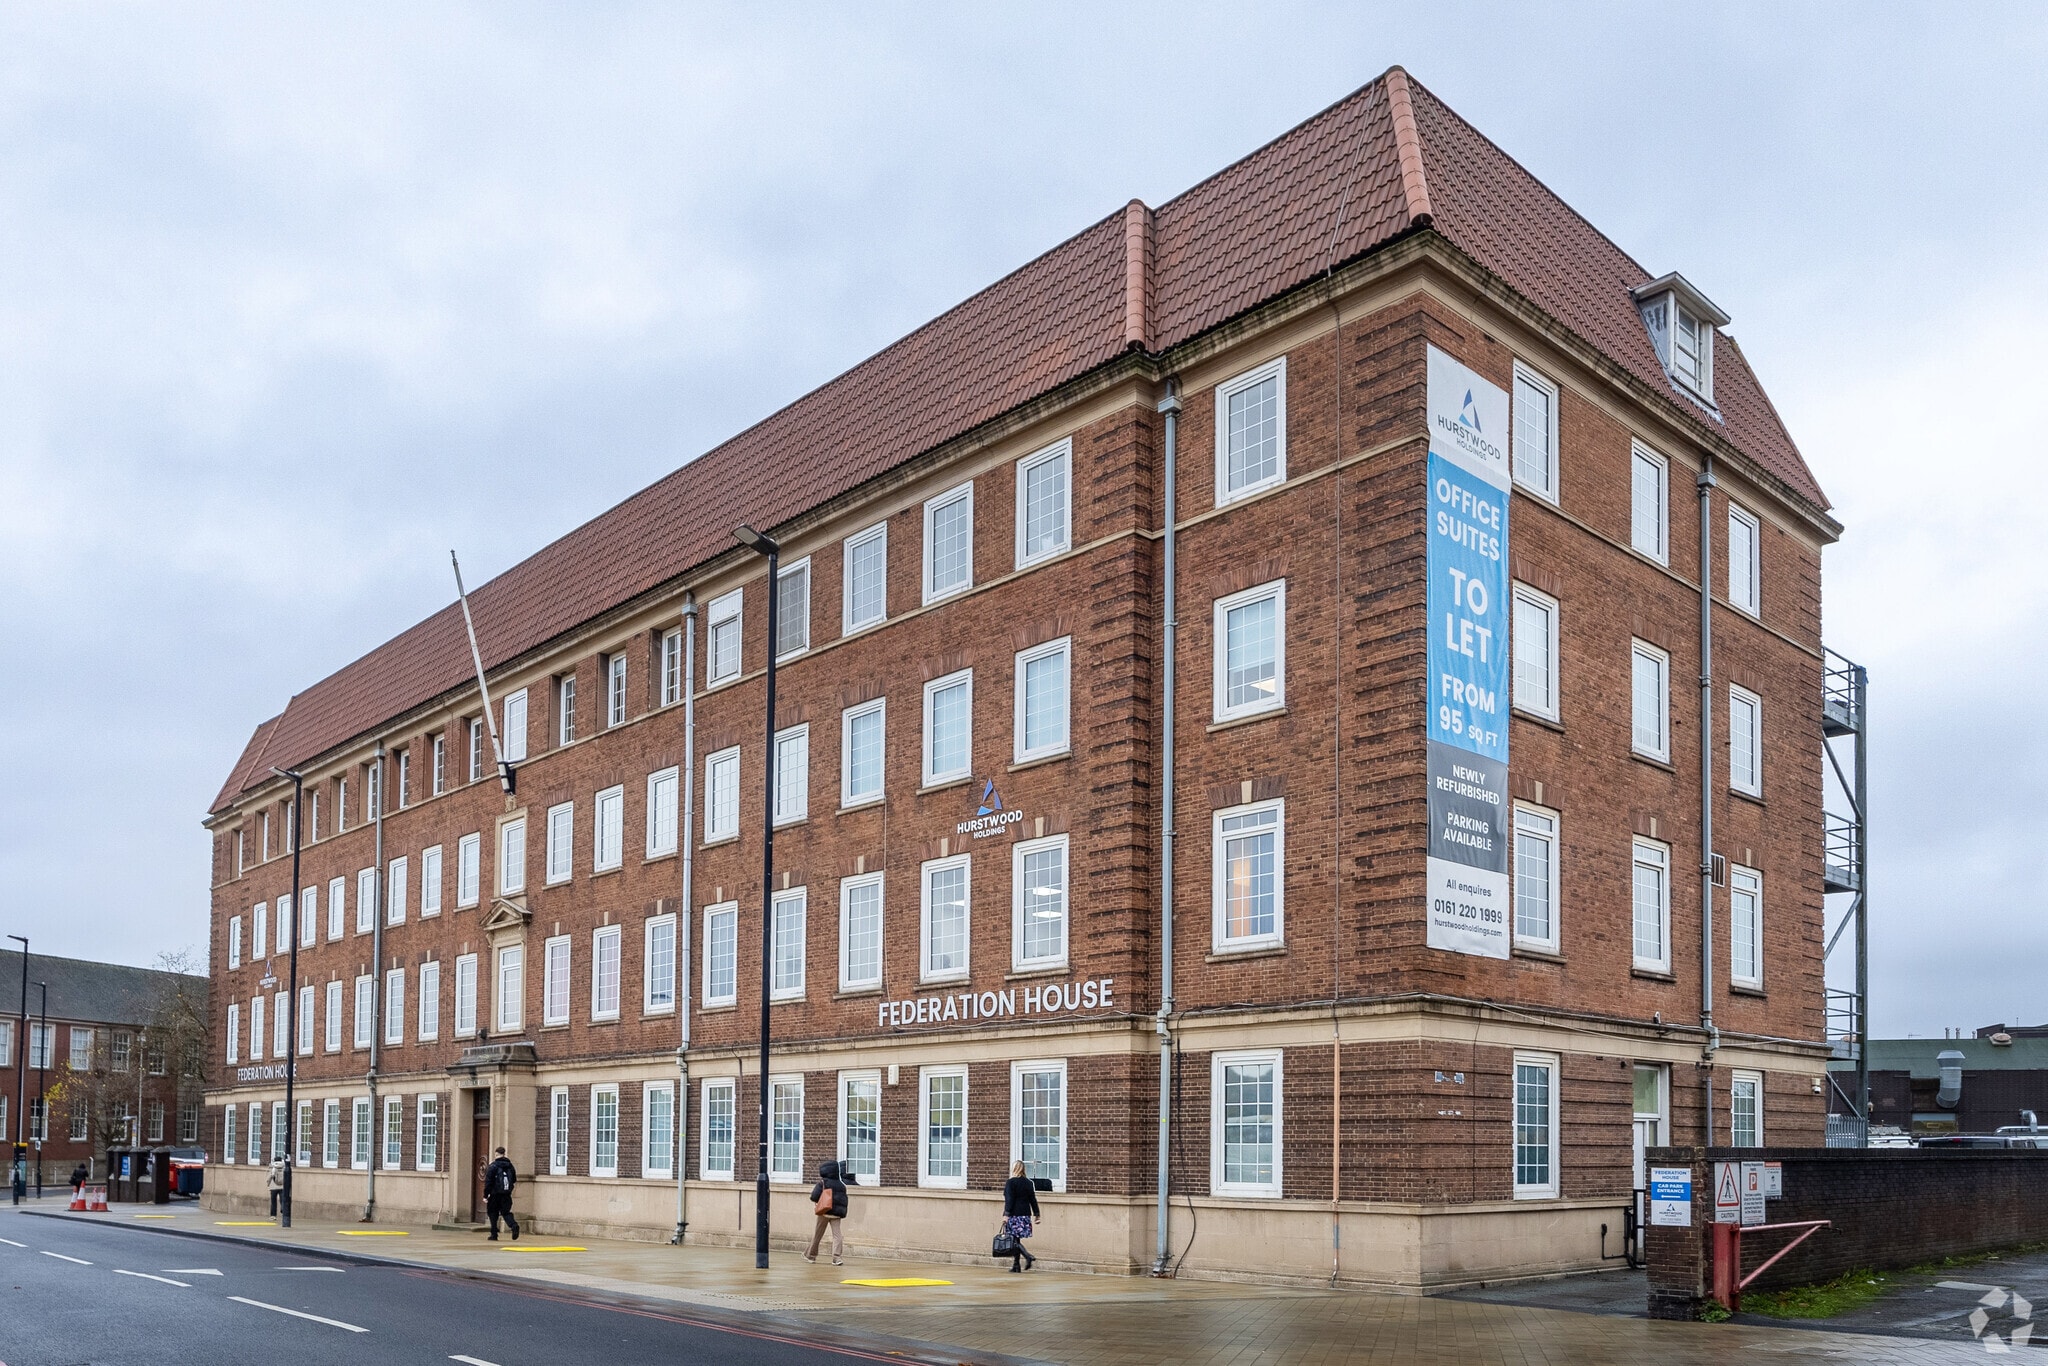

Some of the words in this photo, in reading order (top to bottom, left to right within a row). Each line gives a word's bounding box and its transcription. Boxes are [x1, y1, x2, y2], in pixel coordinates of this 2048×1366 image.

[1438, 415, 1501, 460] HURSTWOOD
[1456, 437, 1487, 461] HOLDINGS
[1436, 478, 1500, 531] OFFICE
[1437, 511, 1500, 561] SUITES
[1449, 567, 1488, 616] TO
[1446, 612, 1492, 664] LET
[1442, 673, 1495, 715] FROM
[1440, 705, 1463, 735] 95
[1468, 724, 1483, 745] SQ
[1485, 731, 1498, 747] FT
[1452, 764, 1486, 785] NEWLY
[1436, 776, 1500, 805] REFURBISHED
[957, 810, 1023, 834] HURSTWOOD
[973, 825, 1006, 839] HOLDINGS
[1447, 812, 1489, 834] PARKING
[1443, 828, 1492, 851] AVAILABLE
[1446, 879, 1457, 890] All
[1458, 883, 1492, 897] enquires
[1434, 898, 1456, 915] 0161
[1459, 903, 1477, 919] 220
[1480, 907, 1503, 924] 1999
[1434, 917, 1503, 937] hurstwoodholdings.com
[878, 989, 1016, 1027] FEDERATION
[1024, 978, 1114, 1014] HOUSE
[237, 1065, 274, 1081] FEDERATION
[275, 1063, 297, 1078] HOUE
